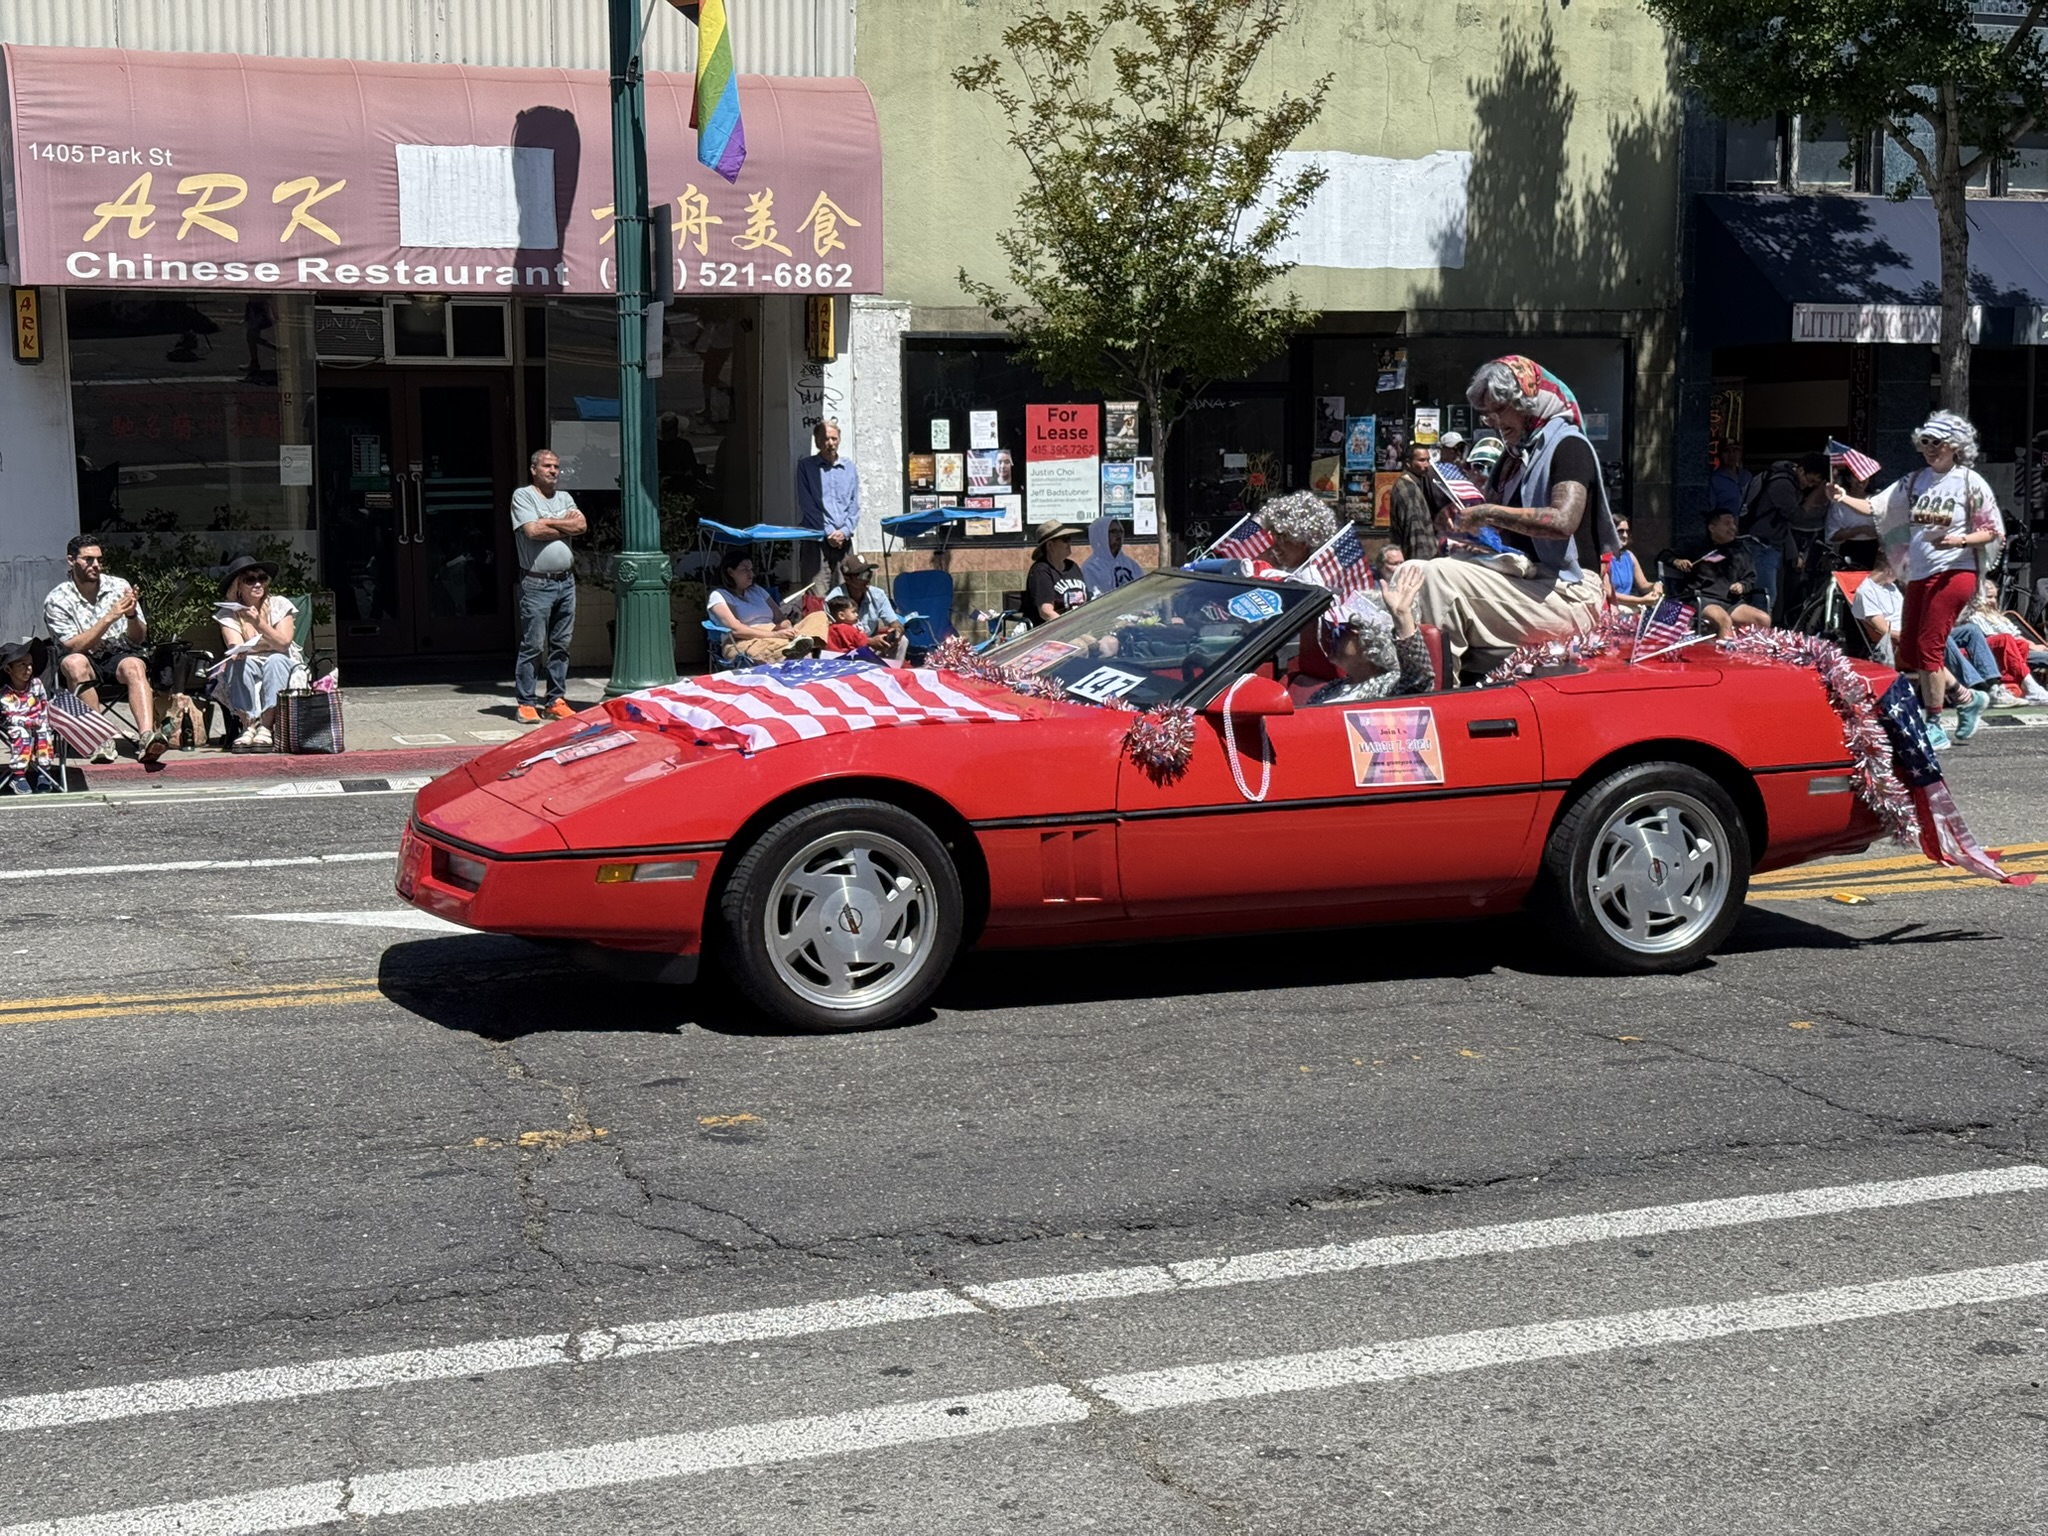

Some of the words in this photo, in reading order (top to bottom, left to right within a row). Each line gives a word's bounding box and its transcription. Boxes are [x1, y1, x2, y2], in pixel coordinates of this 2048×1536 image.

[29, 143, 84, 163] 1405
[91, 145, 143, 166] Park
[149, 147, 173, 166] St
[82, 171, 347, 246] ARK
[66, 251, 280, 283] Chinese
[298, 256, 569, 288] Restaurant
[699, 262, 853, 288] 521-6862
[19, 296, 35, 351] ARK
[1799, 311, 1857, 338] LITTLE
[1047, 408, 1078, 422] For
[1037, 426, 1089, 440] Lease
[1030, 468, 1055, 477] Justin
[1057, 467, 1075, 476] Choi
[1030, 488, 1045, 497] Jeff
[1047, 488, 1089, 496] Badstubner
[1074, 671, 1136, 698] 147
[1359, 740, 1393, 753] MARCH
